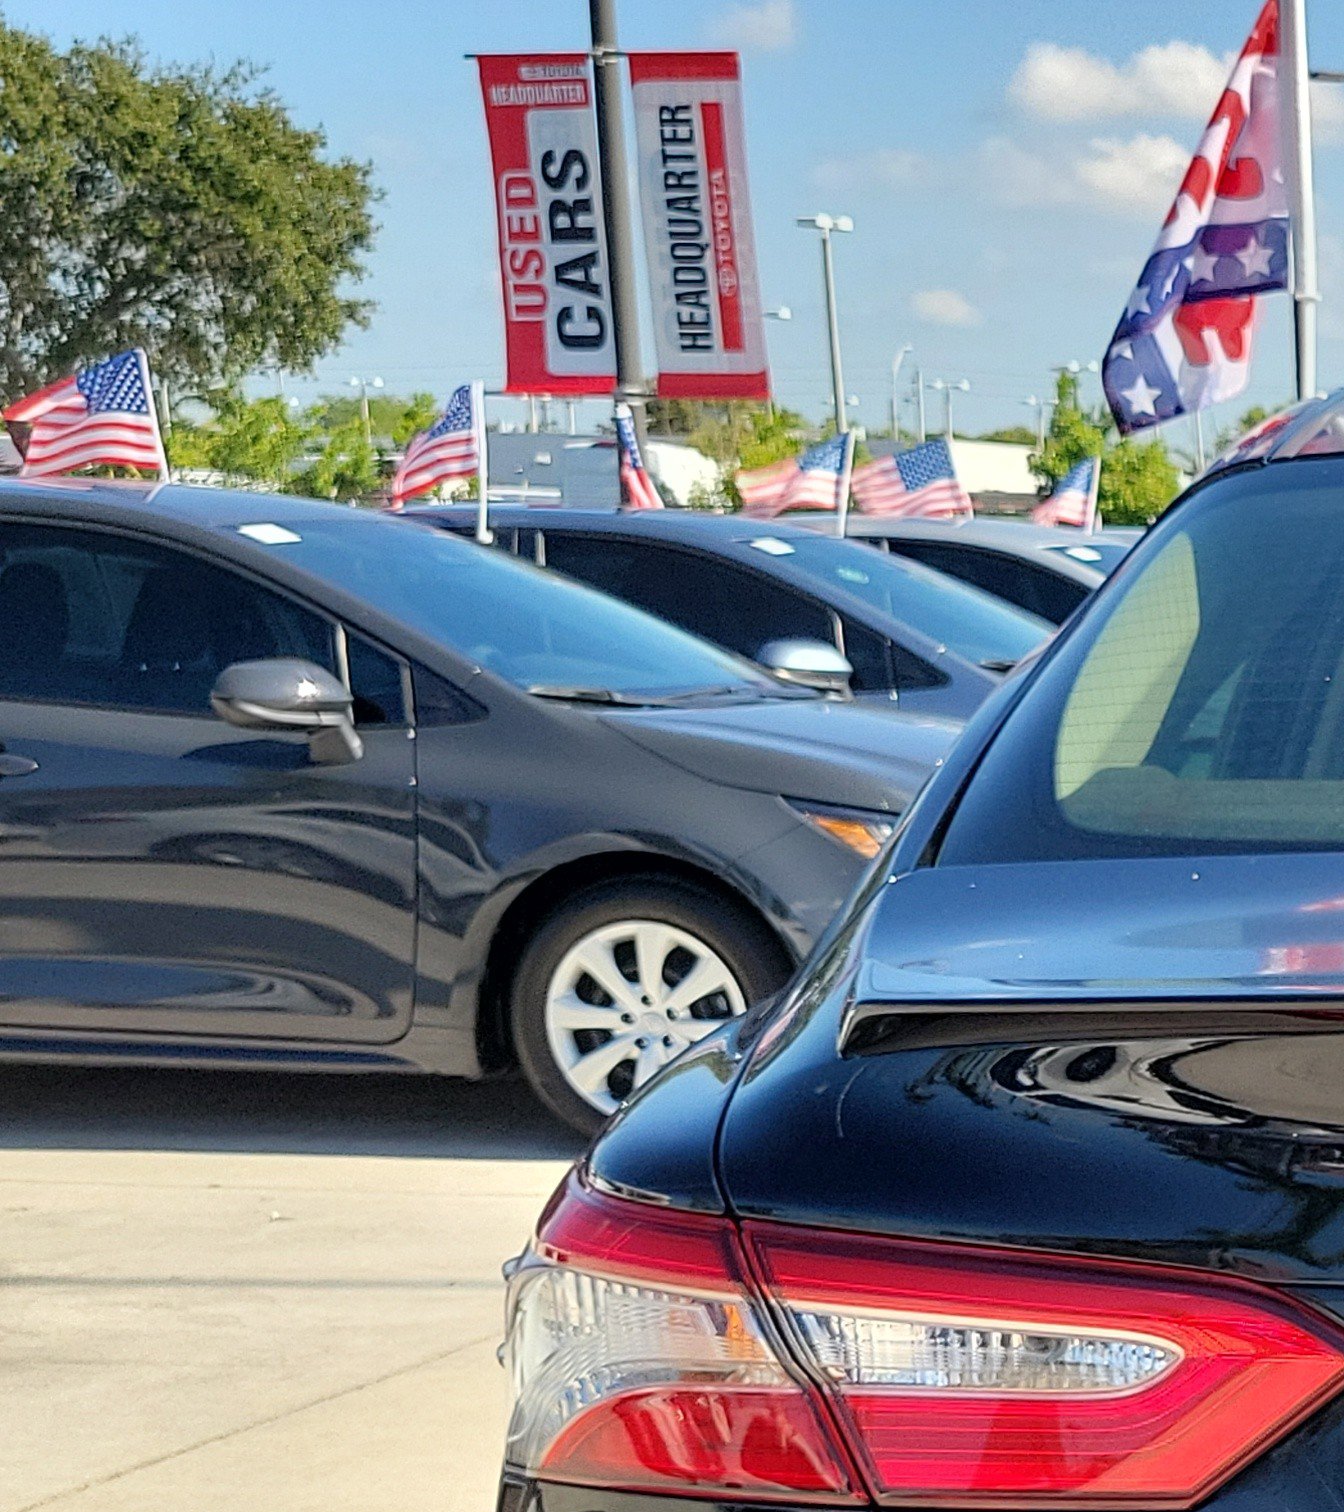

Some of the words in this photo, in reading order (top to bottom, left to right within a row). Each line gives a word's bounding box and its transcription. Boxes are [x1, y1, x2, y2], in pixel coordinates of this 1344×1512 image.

[505, 175, 548, 320] USED
[540, 148, 605, 350] CARS
[658, 103, 714, 353] HEADQUARTER
[710, 170, 735, 268] TOYOTA
